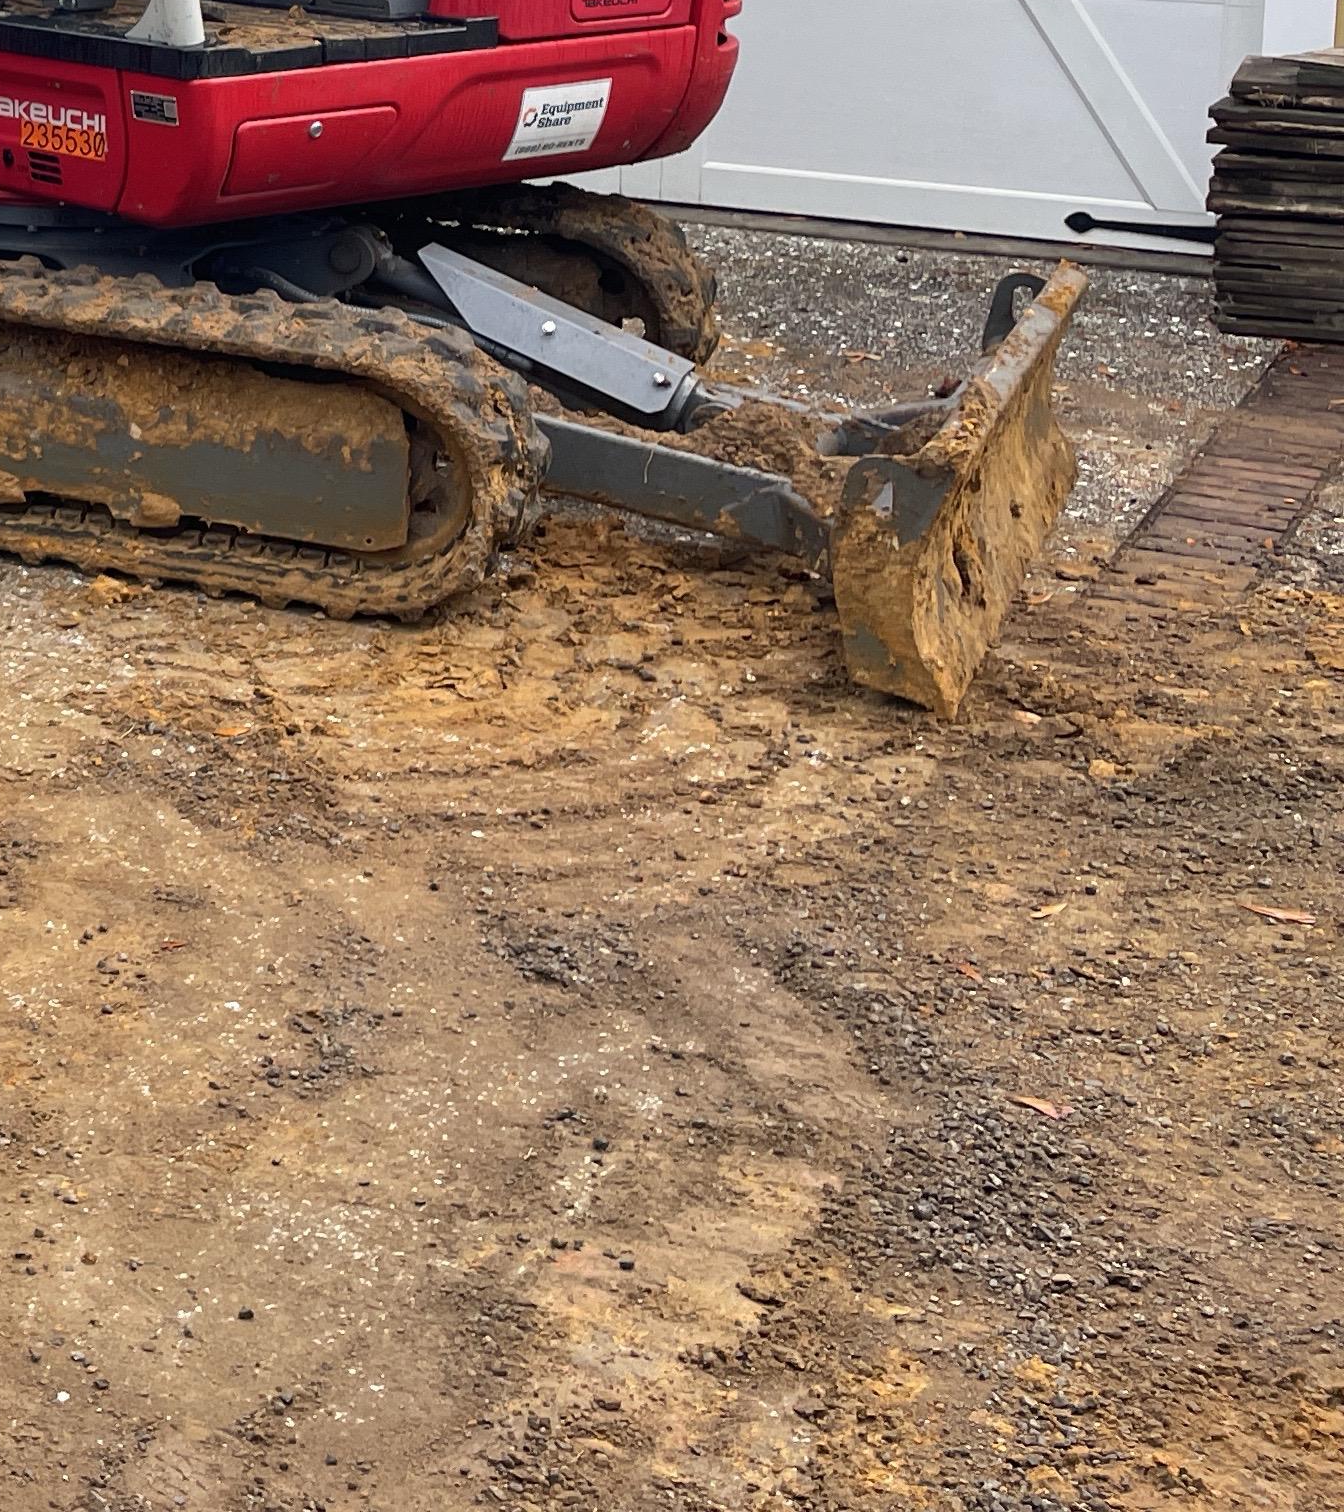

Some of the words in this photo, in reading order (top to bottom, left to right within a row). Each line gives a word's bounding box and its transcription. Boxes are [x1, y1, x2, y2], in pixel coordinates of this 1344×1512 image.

[540, 96, 605, 116] Equipment
[537, 116, 572, 129] Share
[23, 120, 107, 159] 235530
